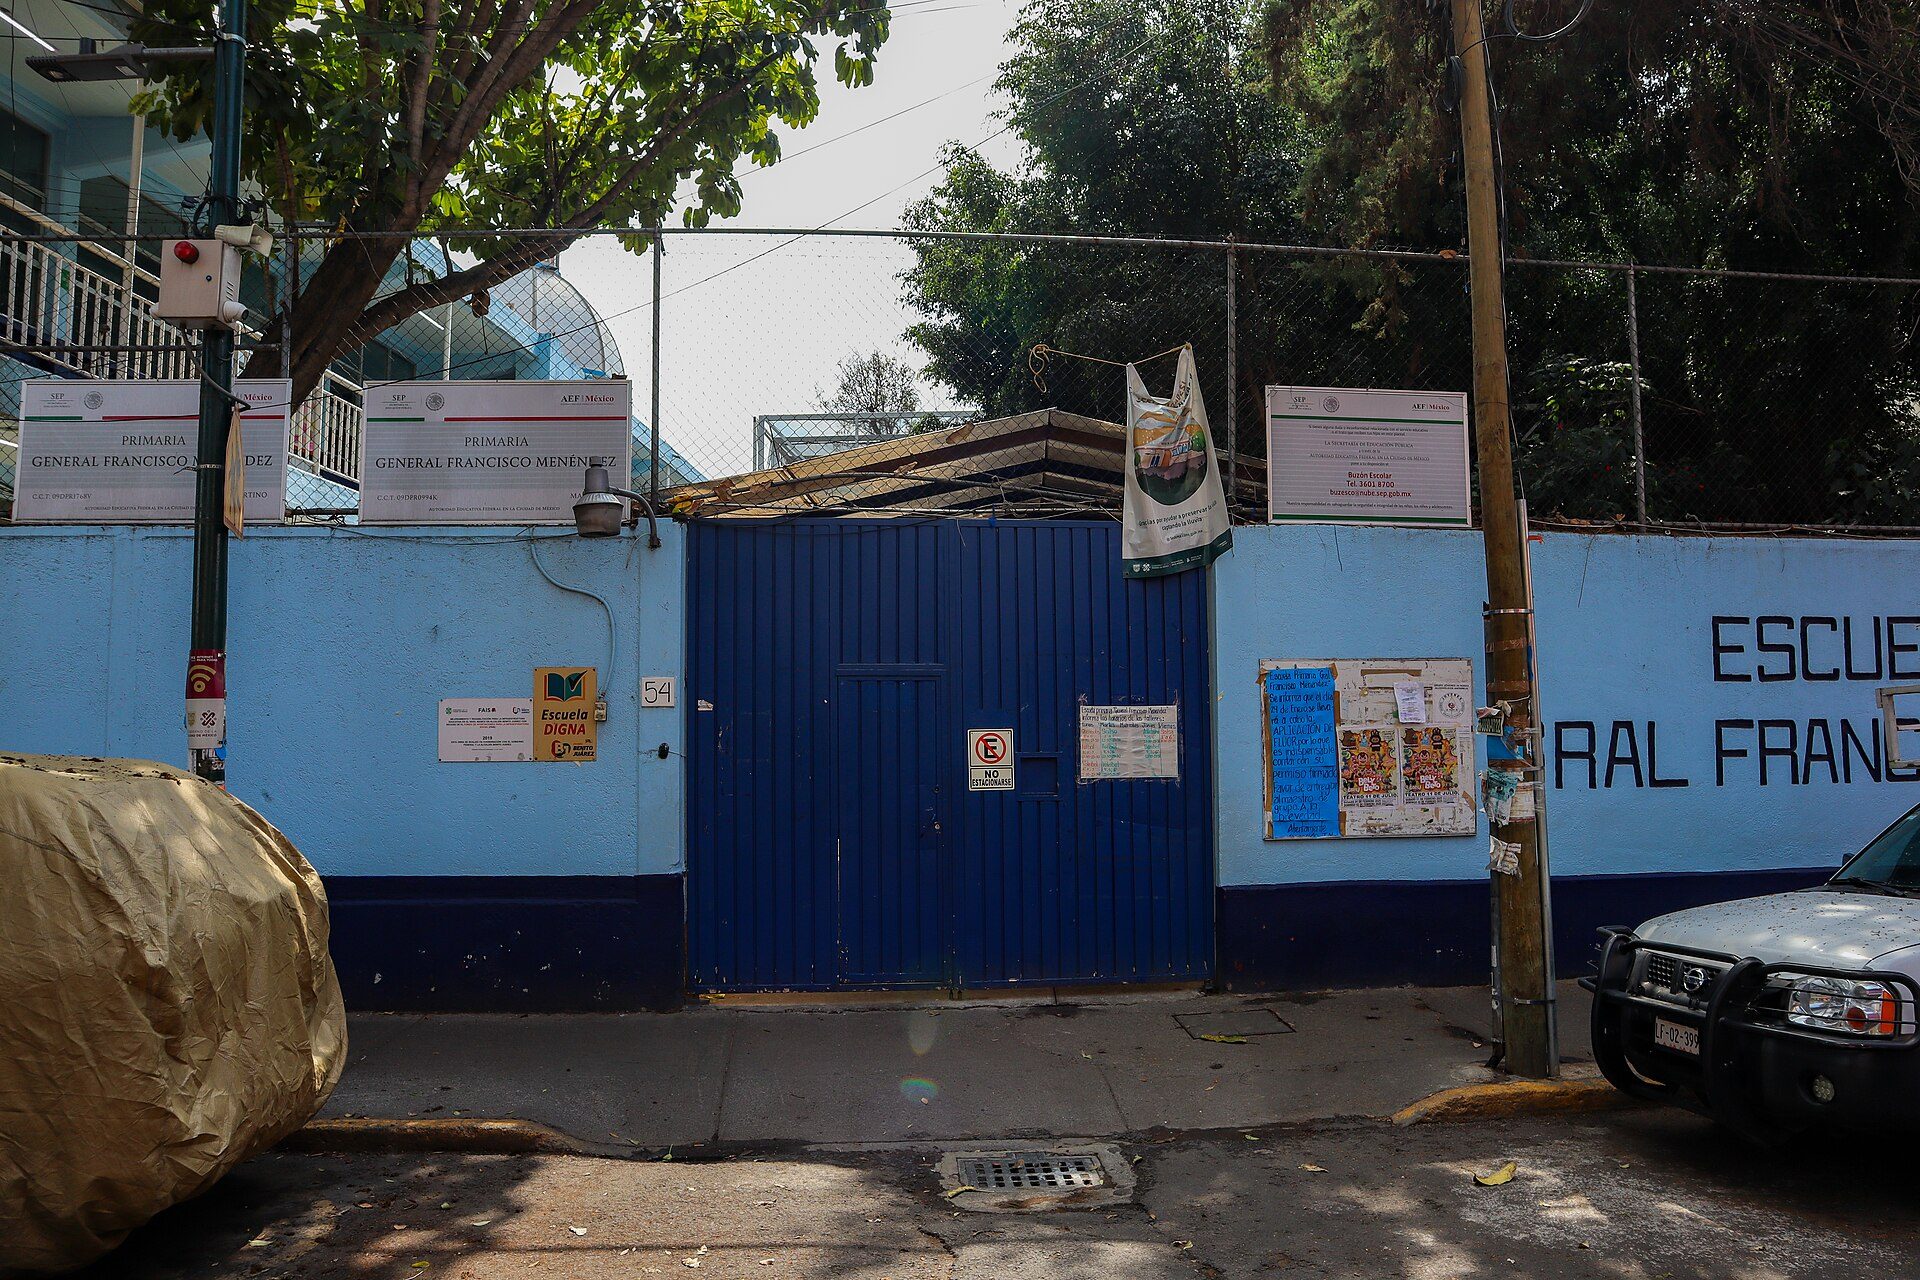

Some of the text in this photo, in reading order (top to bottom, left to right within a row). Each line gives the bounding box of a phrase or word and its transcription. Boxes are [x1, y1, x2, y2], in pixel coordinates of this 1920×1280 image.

[122, 436, 186, 446] PRIMARIA
[465, 437, 528, 446] PRIMARIA
[32, 456, 98, 467] GENERAL
[104, 456, 188, 467] FRANCISCO
[376, 454, 616, 468] GENERAL FRANCISCO MENÉNEZ
[645, 681, 671, 703] 54
[1303, 694, 1313, 703] que
[542, 709, 588, 720] Escuela
[1280, 705, 1288, 714] de
[544, 723, 586, 735] DIGNA
[1324, 724, 1333, 732] DE
[984, 738, 998, 758] E
[1540, 718, 1689, 790] RAL
[985, 770, 999, 778] NO
[1656, 1023, 1699, 1048] LF-02-399
